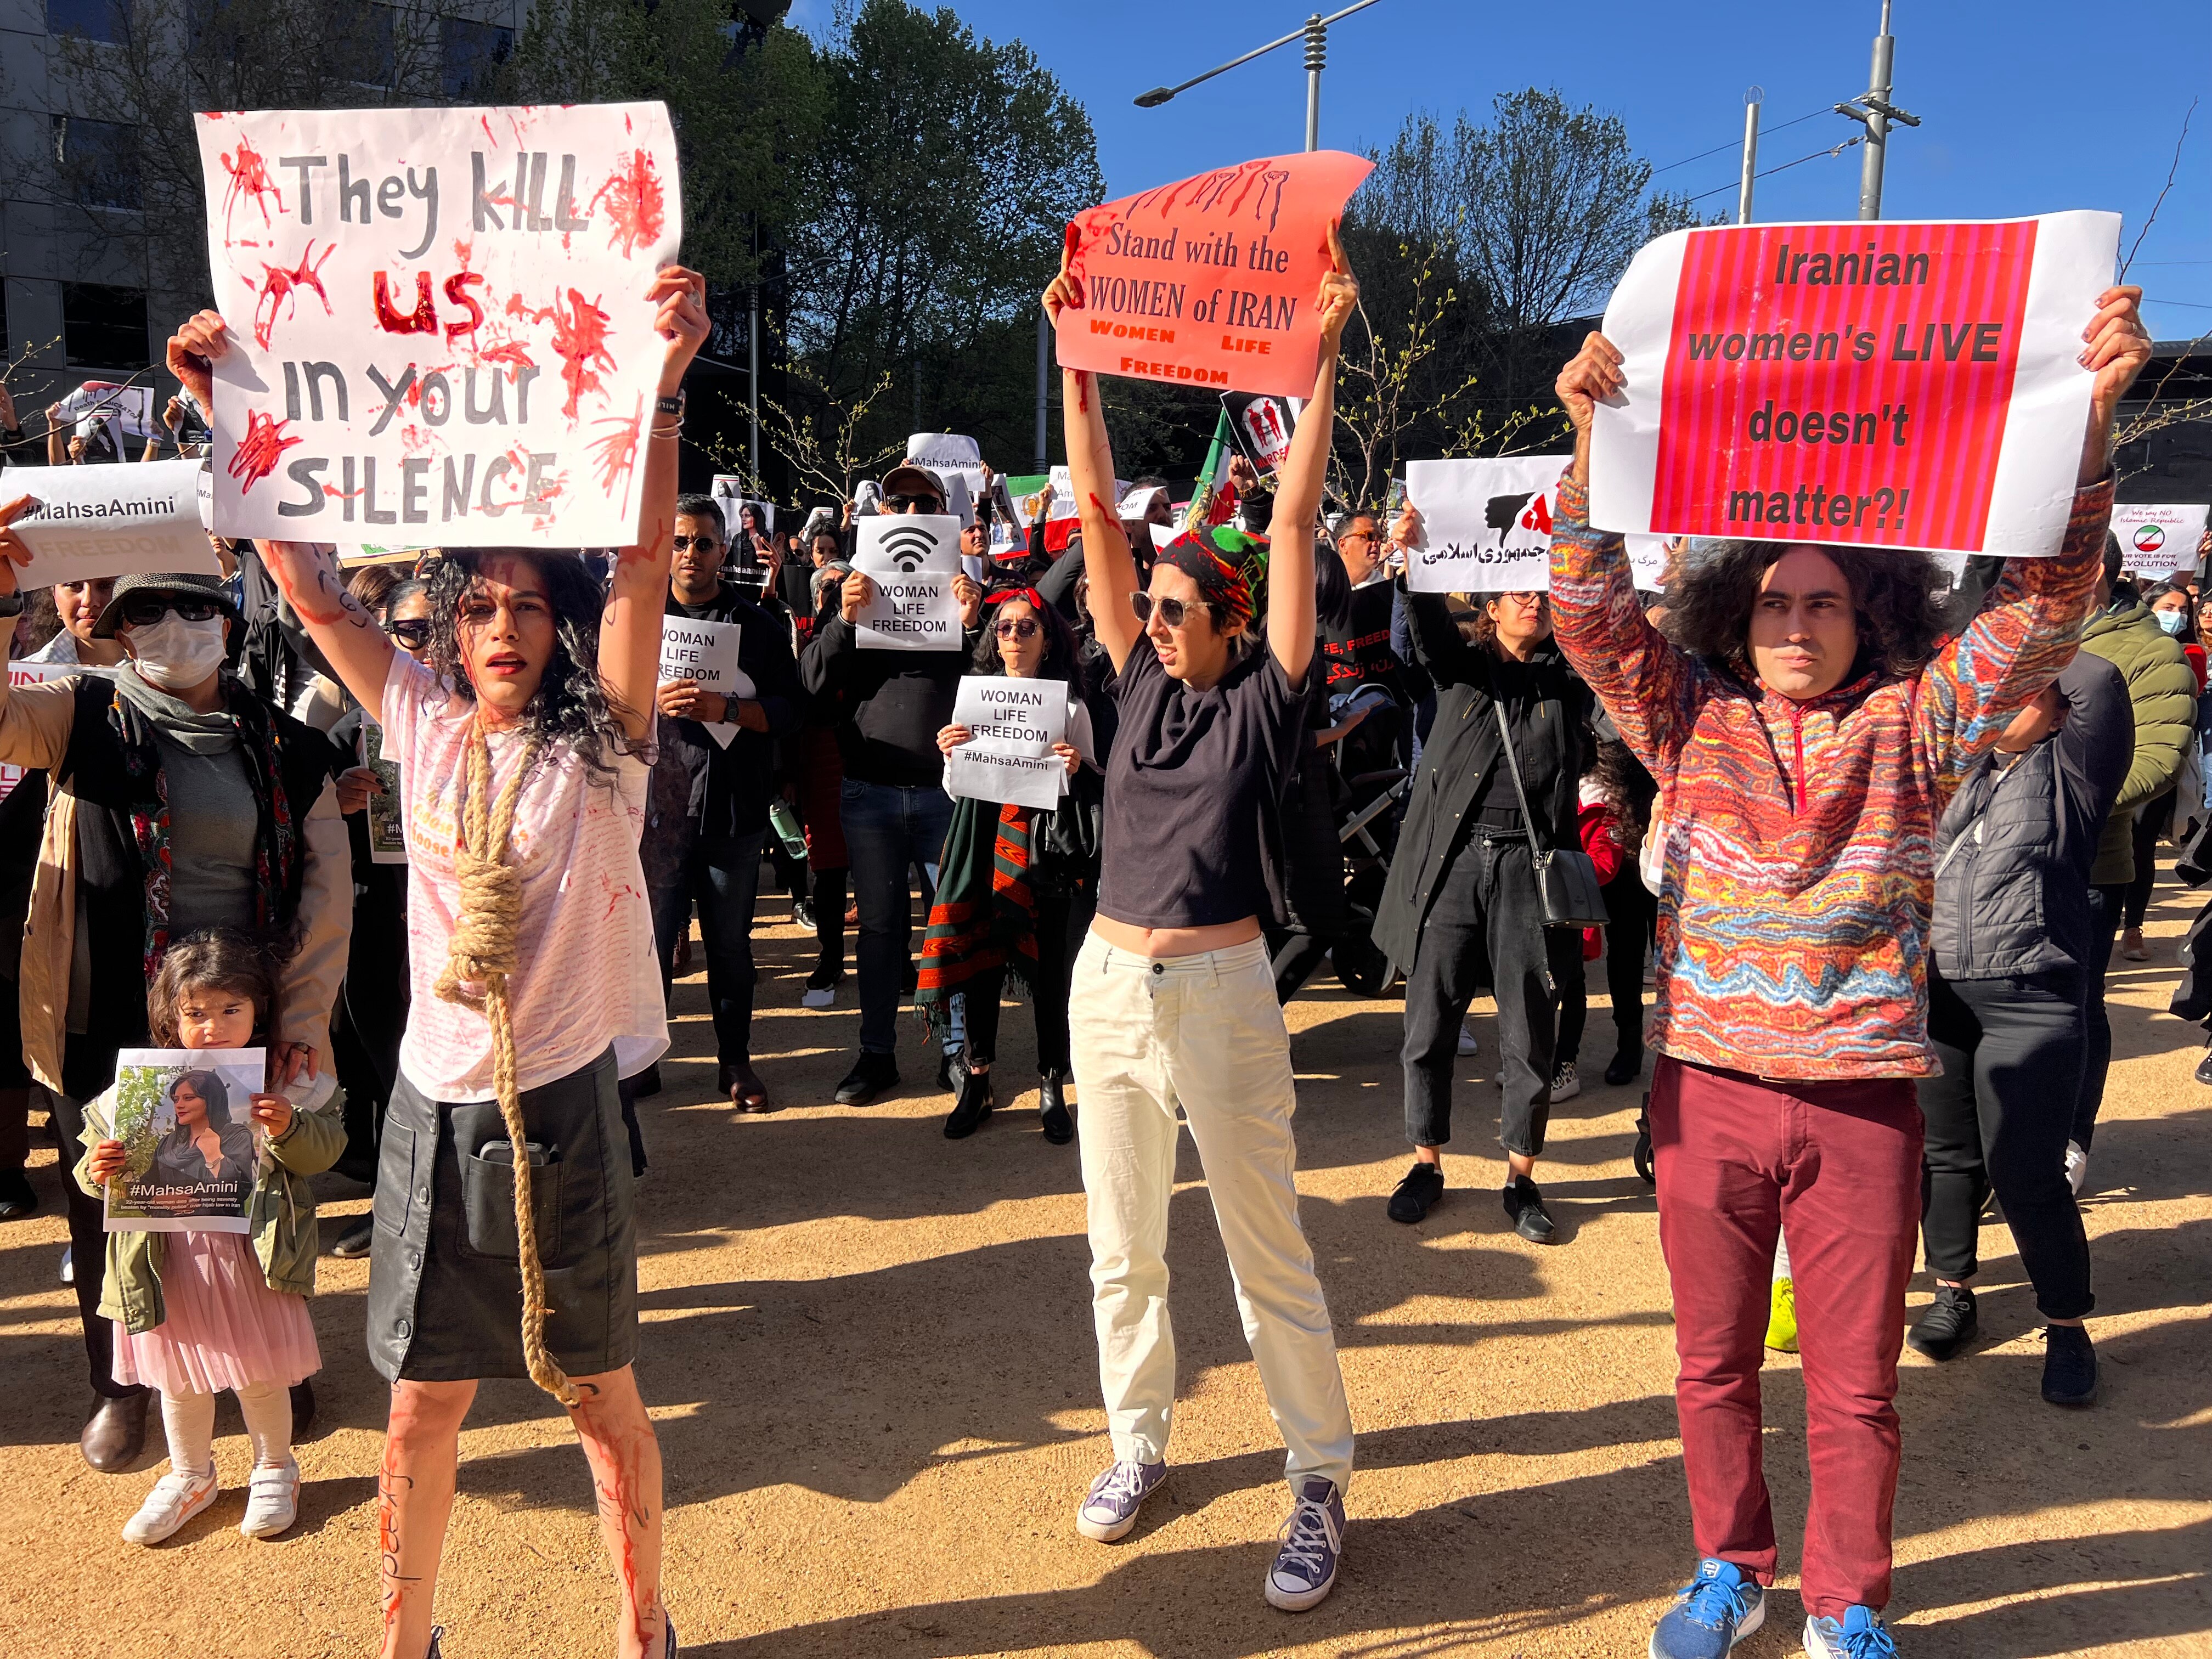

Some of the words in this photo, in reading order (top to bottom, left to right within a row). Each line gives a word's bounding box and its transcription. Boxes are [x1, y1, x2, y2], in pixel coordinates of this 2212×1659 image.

[280, 153, 438, 259] They
[1106, 222, 1178, 261] Stand
[1185, 232, 1238, 267] with
[1249, 235, 1289, 273] the
[1774, 242, 1929, 285] Iranian
[1090, 275, 1187, 319] WOMEN
[1193, 289, 1223, 323] of
[1226, 291, 1297, 331] IRAN
[1090, 319, 1175, 343] WOMEN
[1221, 335, 1271, 354] LIFE
[1687, 325, 1876, 362] women's
[1891, 323, 2004, 362] LIVE
[1120, 357, 1228, 384] FREEDOM
[366, 363, 541, 437] your
[1748, 400, 1910, 446] doesn't
[278, 453, 556, 524] SILENCE
[21, 496, 175, 521] #MahsaAmini
[1728, 484, 1910, 530] matter?!
[878, 585, 938, 597] WOMAN
[893, 603, 925, 614] LIFE
[872, 620, 946, 632] FREEDOM
[667, 647, 699, 663] LIFE
[659, 663, 720, 680] REEDOM
[980, 689, 1042, 706] WOMAN
[994, 709, 1027, 723] LIFE
[971, 724, 1048, 742] FREEDOM
[964, 751, 1048, 770] #MahsaAmini
[129, 1180, 239, 1197] #MahsaAmini
